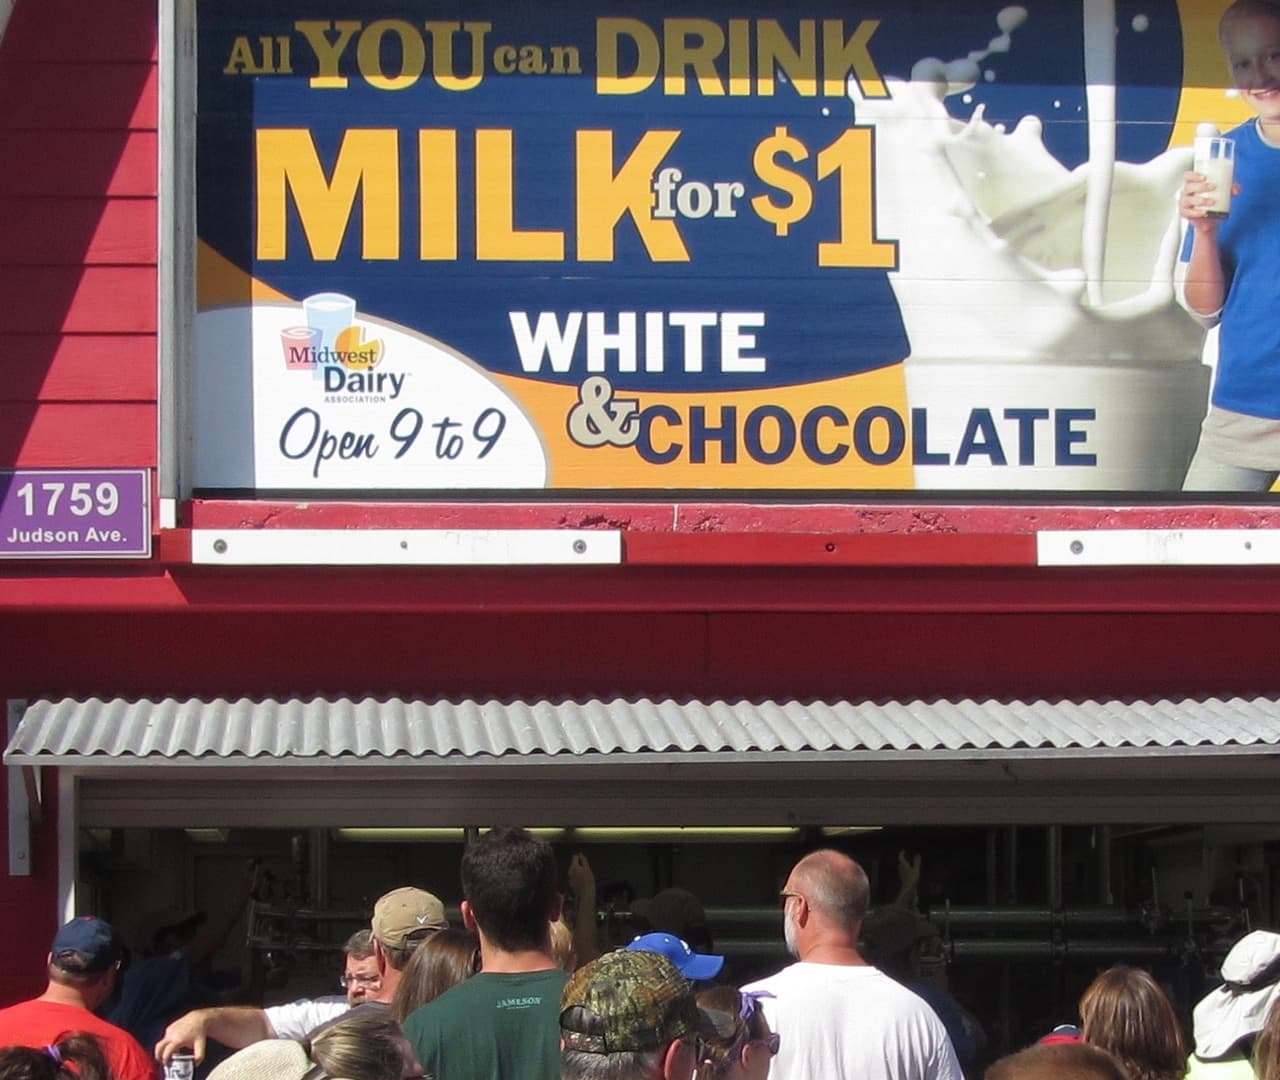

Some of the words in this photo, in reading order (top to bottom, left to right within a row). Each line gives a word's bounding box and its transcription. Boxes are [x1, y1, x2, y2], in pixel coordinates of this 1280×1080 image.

[223, 36, 294, 75] All
[294, 18, 493, 92] YOU
[492, 44, 583, 75] can
[595, 17, 893, 98] DRINK
[255, 127, 691, 262] MILK
[651, 167, 746, 219] for
[750, 124, 899, 270] $1
[289, 346, 377, 364] Midwest
[508, 311, 767, 373] WHITE
[323, 395, 386, 404] ASSOCIATION
[324, 365, 406, 399] Dairy
[279, 406, 379, 478] Open
[389, 407, 424, 460] 9
[431, 416, 464, 460] to
[472, 407, 507, 460] 9
[567, 376, 640, 448] &
[634, 404, 1098, 467] CHOCOLATE
[17, 481, 120, 517] 1759
[6, 527, 79, 543] Judson
[84, 526, 127, 542] Ave.
